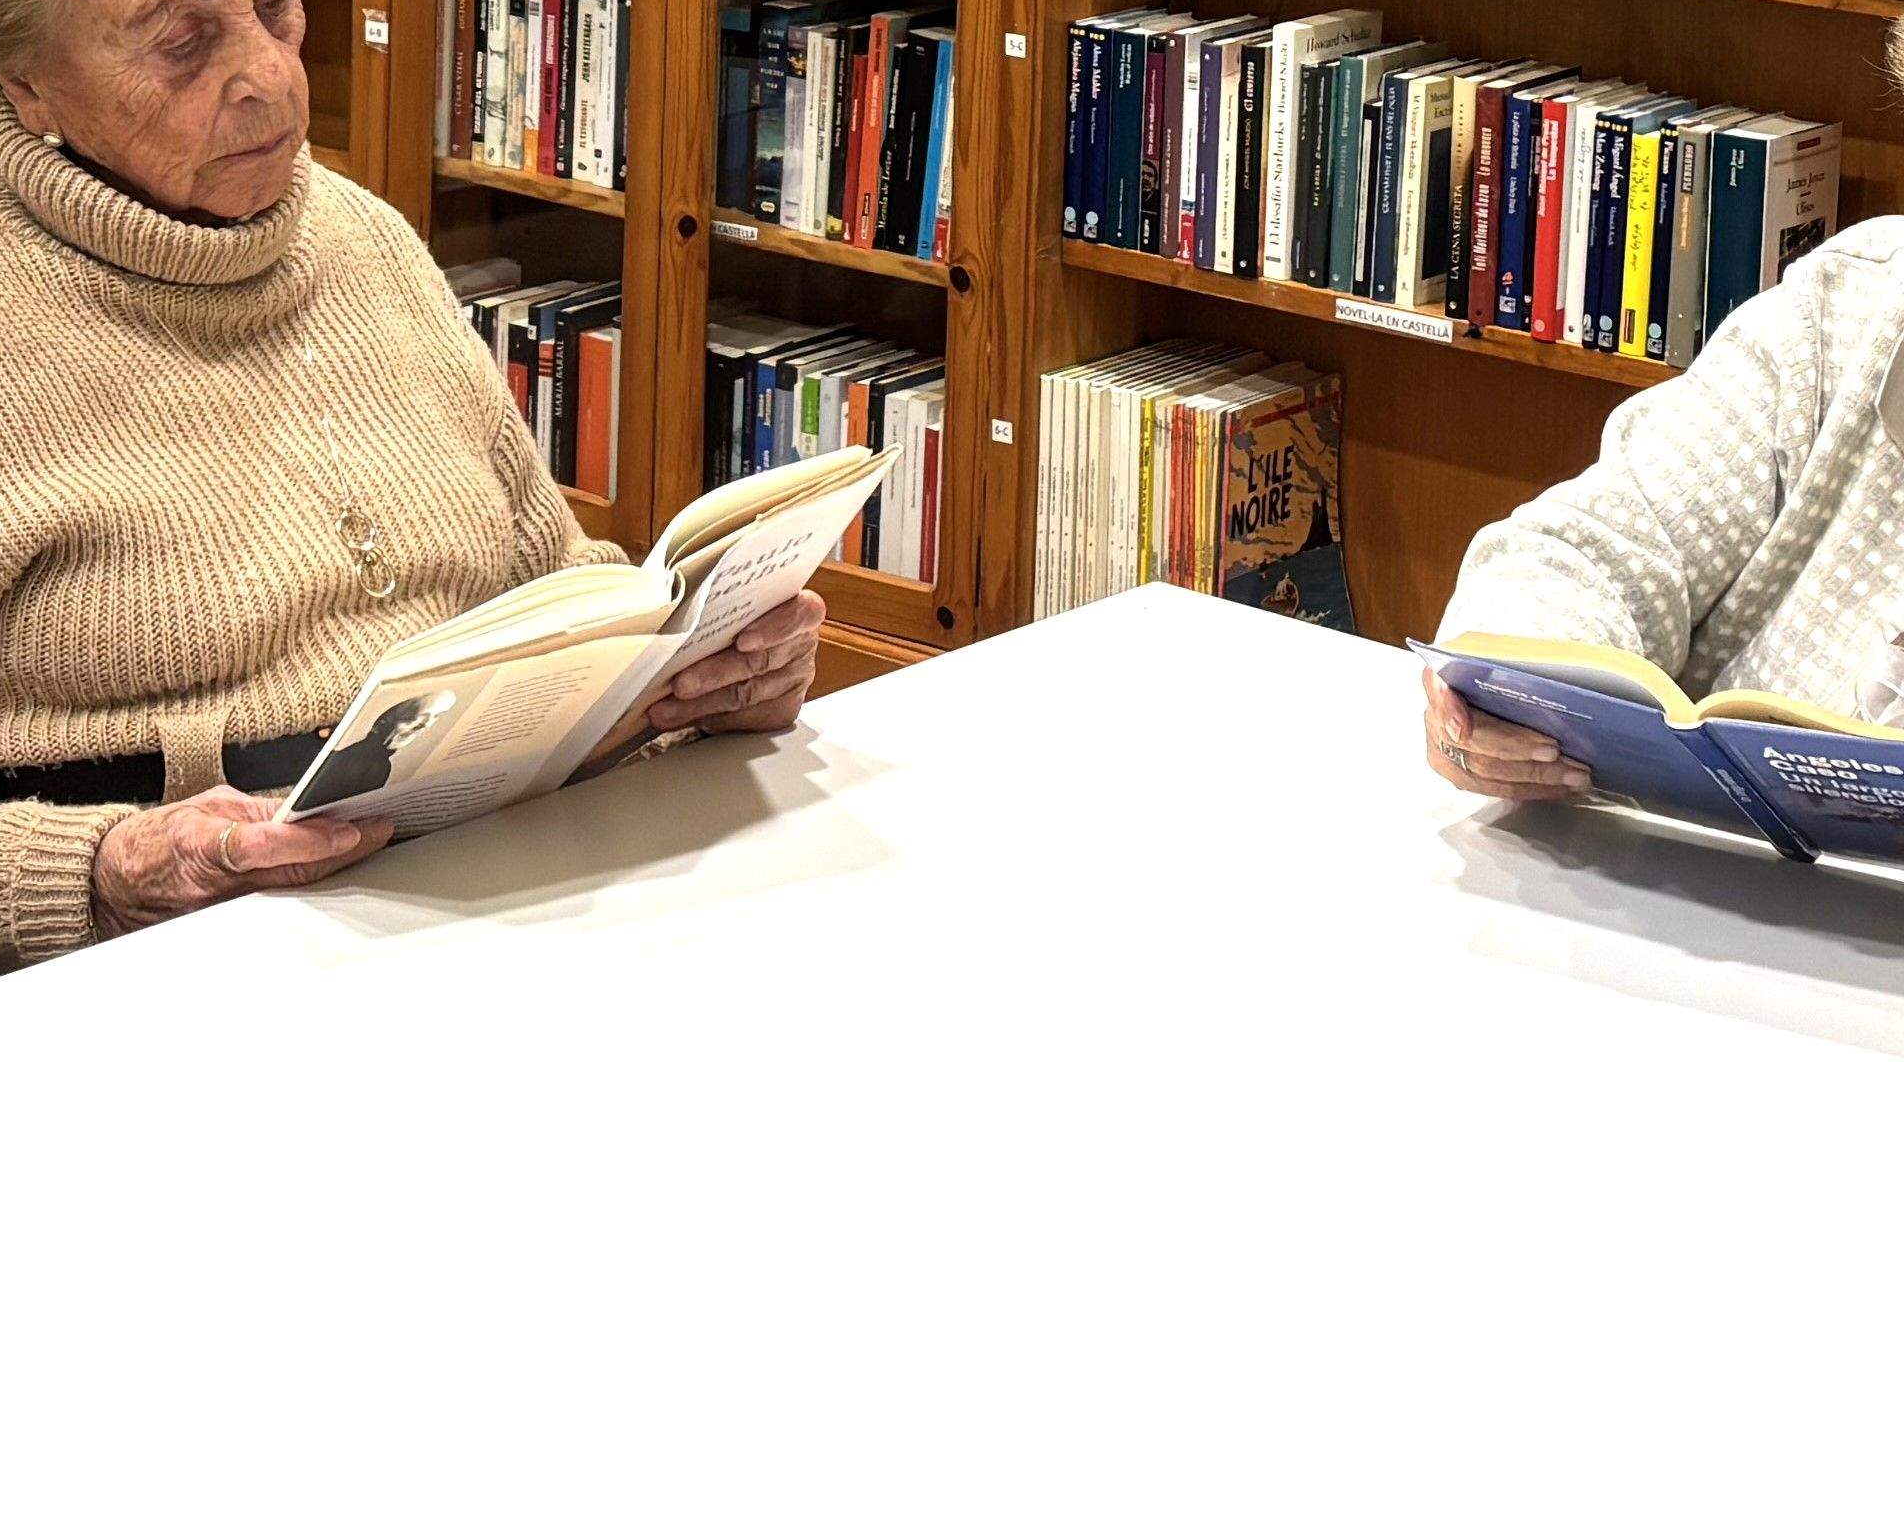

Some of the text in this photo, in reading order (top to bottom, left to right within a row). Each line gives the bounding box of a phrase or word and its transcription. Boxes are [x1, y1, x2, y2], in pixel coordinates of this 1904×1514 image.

[1273, 121, 1285, 184] Starbucks
[1450, 266, 1460, 281] LA
[1247, 443, 1296, 493] L'ILE
[1231, 484, 1293, 539] NOIRE
[1762, 746, 1904, 776] Angeles
[1769, 759, 1859, 781] Caso
